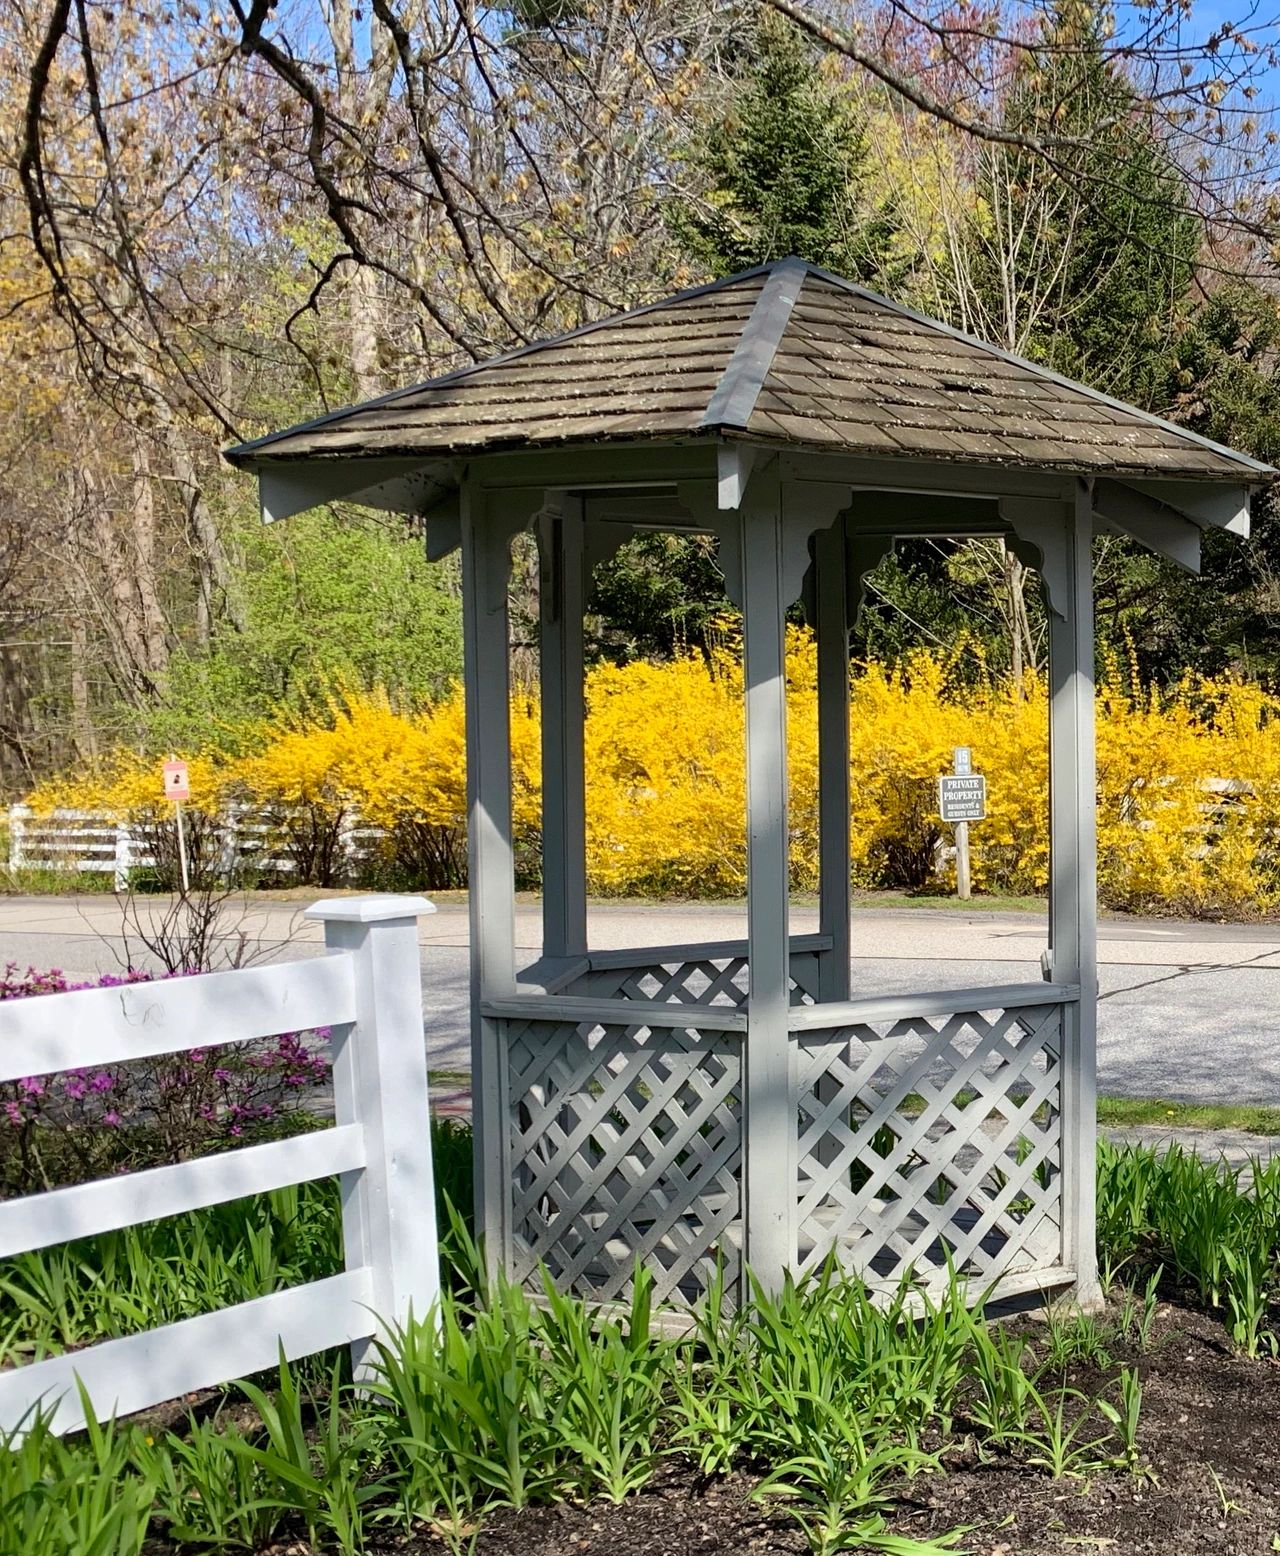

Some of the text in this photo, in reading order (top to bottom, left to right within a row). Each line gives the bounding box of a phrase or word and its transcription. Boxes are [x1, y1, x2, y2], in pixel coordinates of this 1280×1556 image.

[957, 750, 968, 764] 15
[948, 780, 979, 789] PRIVATE
[944, 791, 982, 800] PROPERTY
